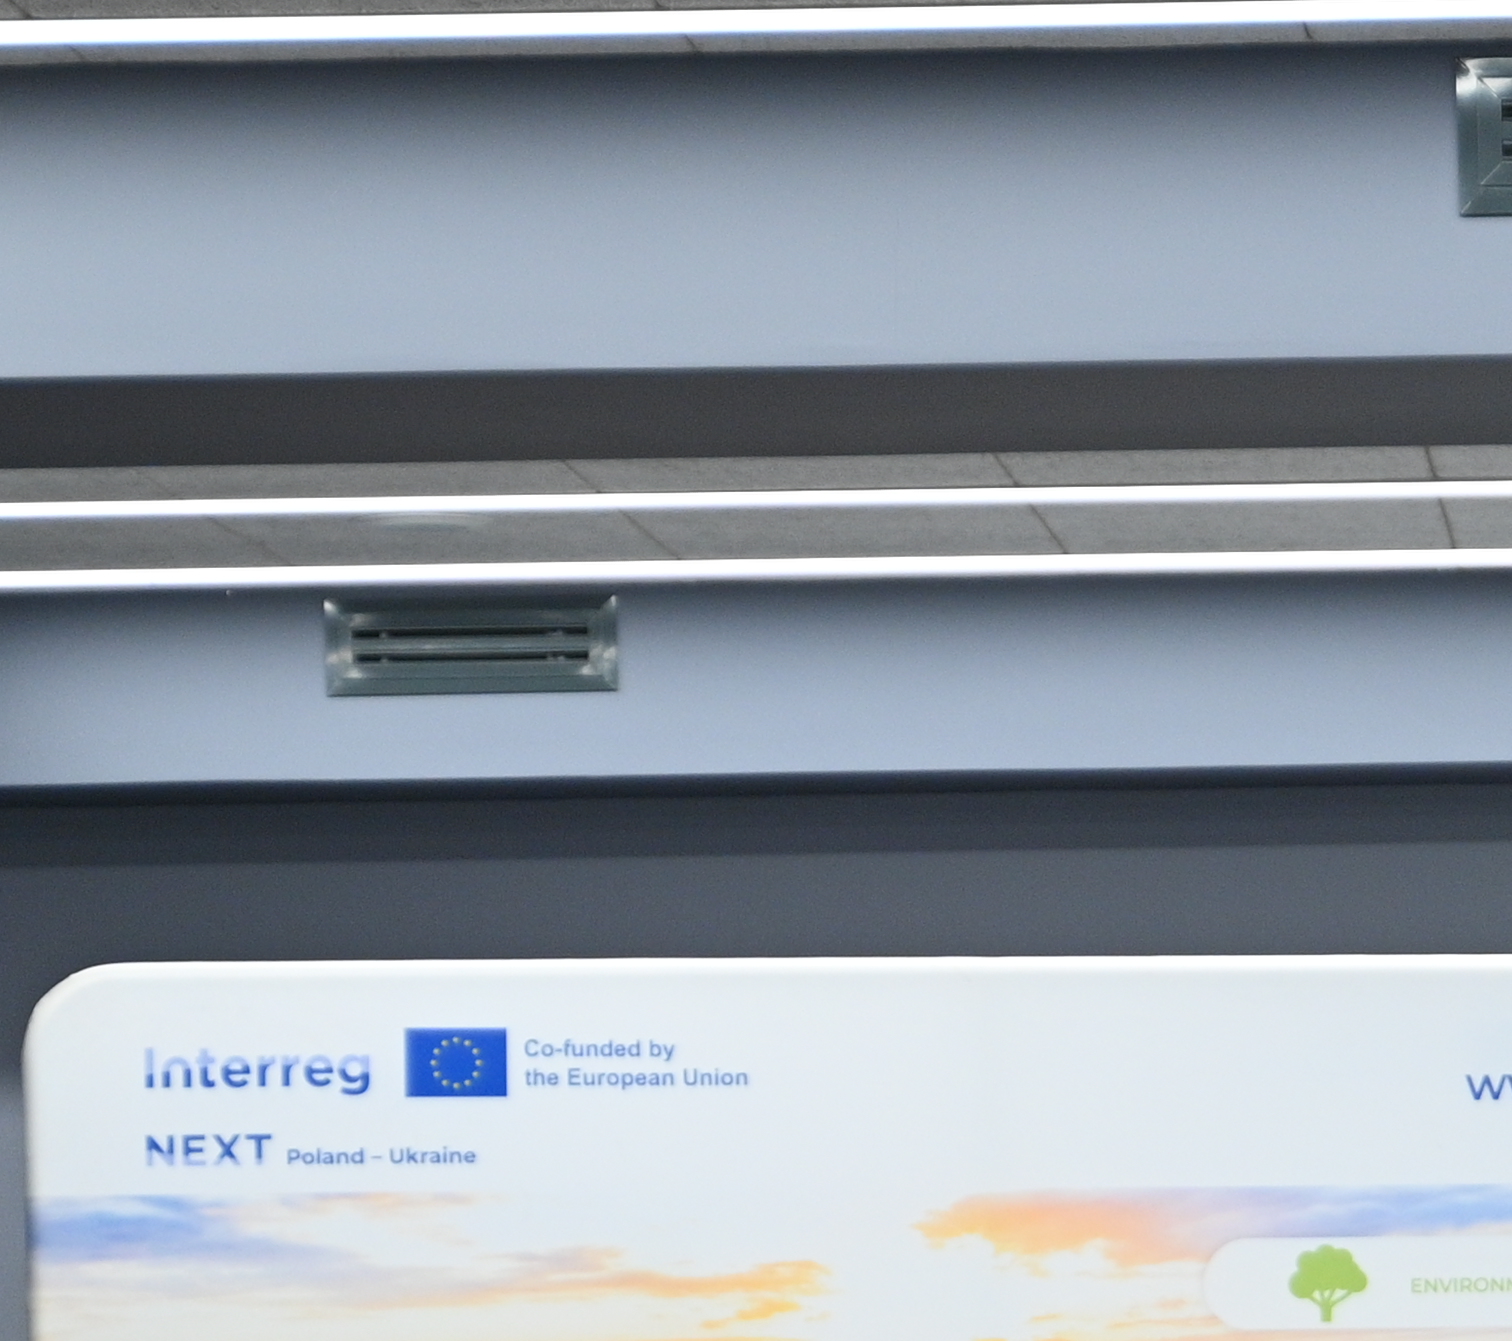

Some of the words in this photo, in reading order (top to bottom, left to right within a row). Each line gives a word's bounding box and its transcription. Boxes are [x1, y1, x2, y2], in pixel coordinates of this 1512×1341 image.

[524, 1038, 640, 1057] Co-funded
[649, 1038, 675, 1061] by
[144, 1047, 370, 1095] Interreg
[525, 1068, 559, 1086] the
[567, 1067, 675, 1090] European
[683, 1067, 748, 1086] Union
[145, 1133, 272, 1166] NEXT
[286, 1146, 364, 1165] Poland
[389, 1146, 476, 1165] Ukraine
